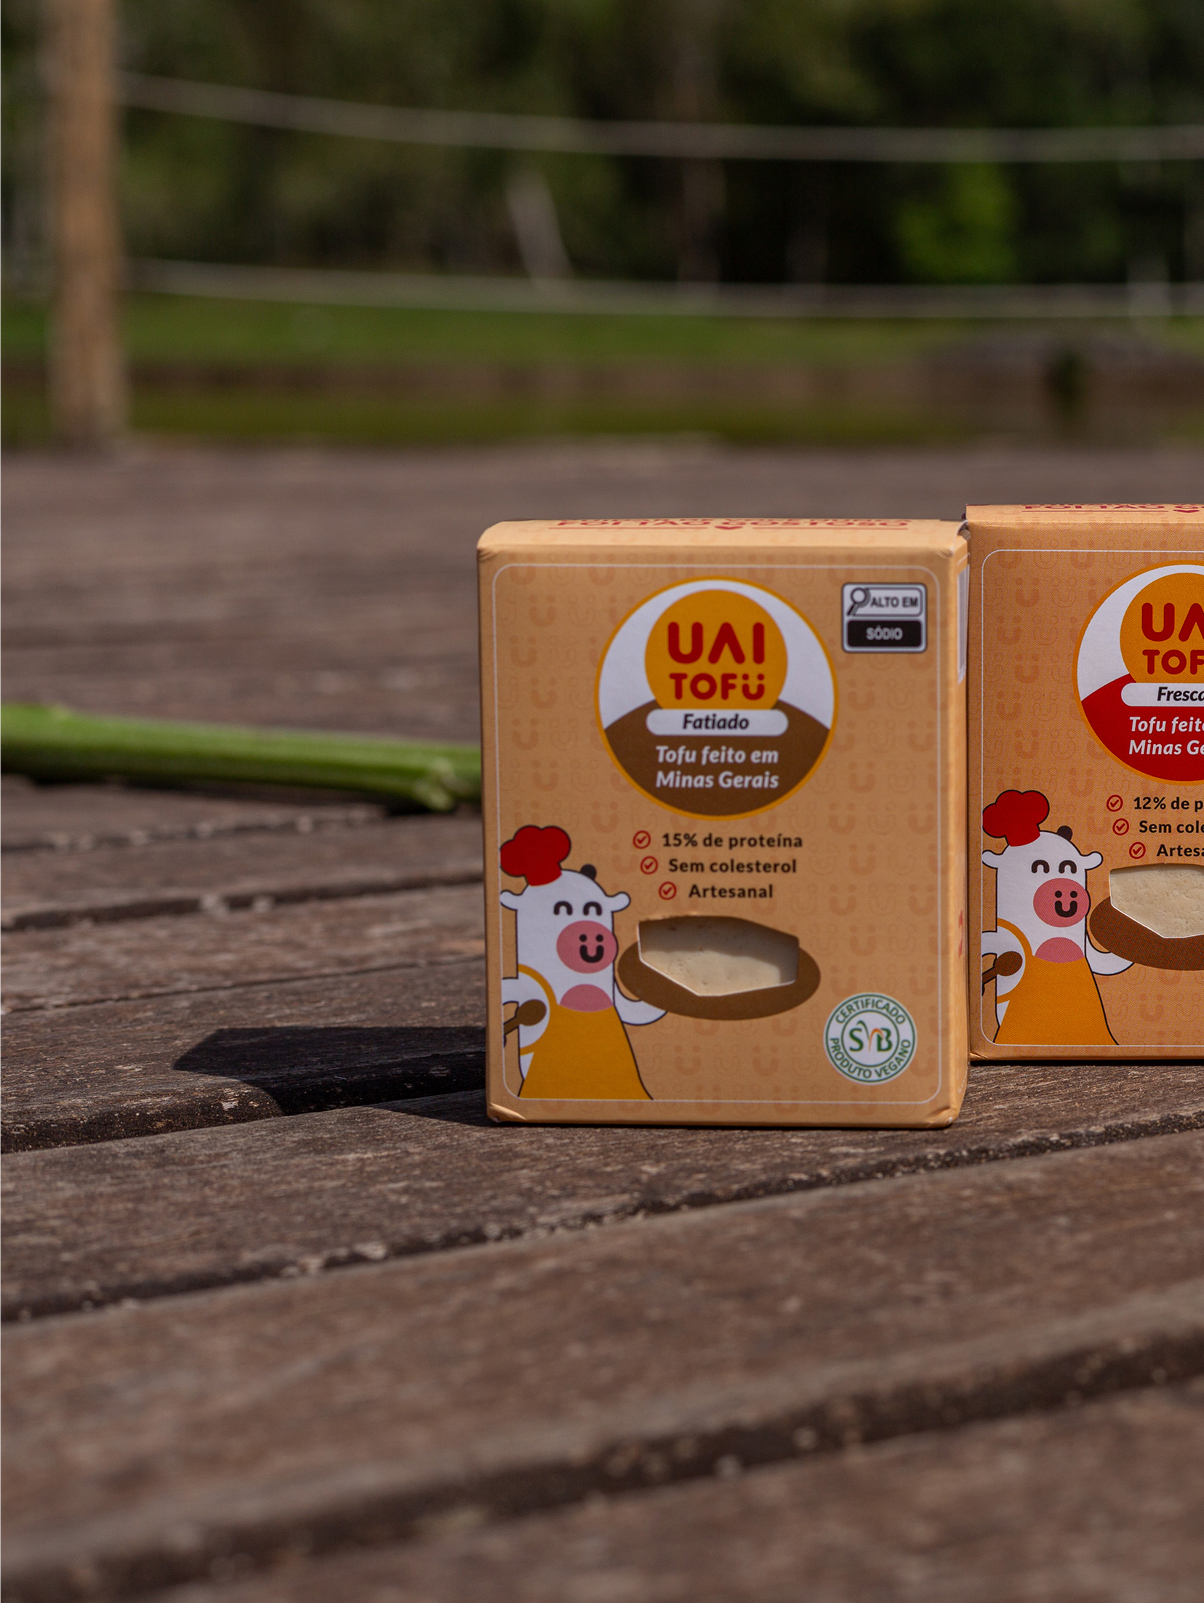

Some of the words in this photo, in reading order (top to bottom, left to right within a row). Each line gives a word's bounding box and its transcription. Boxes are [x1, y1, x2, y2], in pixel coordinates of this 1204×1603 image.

[870, 596, 900, 609] ALTO
[902, 596, 919, 609] EM
[865, 624, 904, 641] SÓDIO
[667, 622, 765, 665] UAI
[682, 712, 750, 732] Fatiado
[1129, 716, 1167, 735] Tofu
[656, 745, 697, 767] Tofu
[700, 745, 748, 767] feito
[749, 749, 779, 764] em
[1128, 739, 1183, 756] Minas
[656, 771, 714, 789] Minas
[718, 771, 779, 790] Gerais
[1133, 796, 1167, 811] 12%
[1170, 796, 1191, 811] de
[1138, 820, 1173, 835] Sem
[662, 833, 698, 848] 15%
[702, 833, 724, 848] de
[728, 833, 803, 852] proteína
[668, 859, 705, 874] Sem
[709, 858, 798, 874] colesterol
[688, 883, 774, 899] Artesanal
[835, 997, 906, 1024] CERTIFICADO
[830, 1037, 872, 1079] PRODUTO
[874, 1039, 911, 1078] VEGANO
